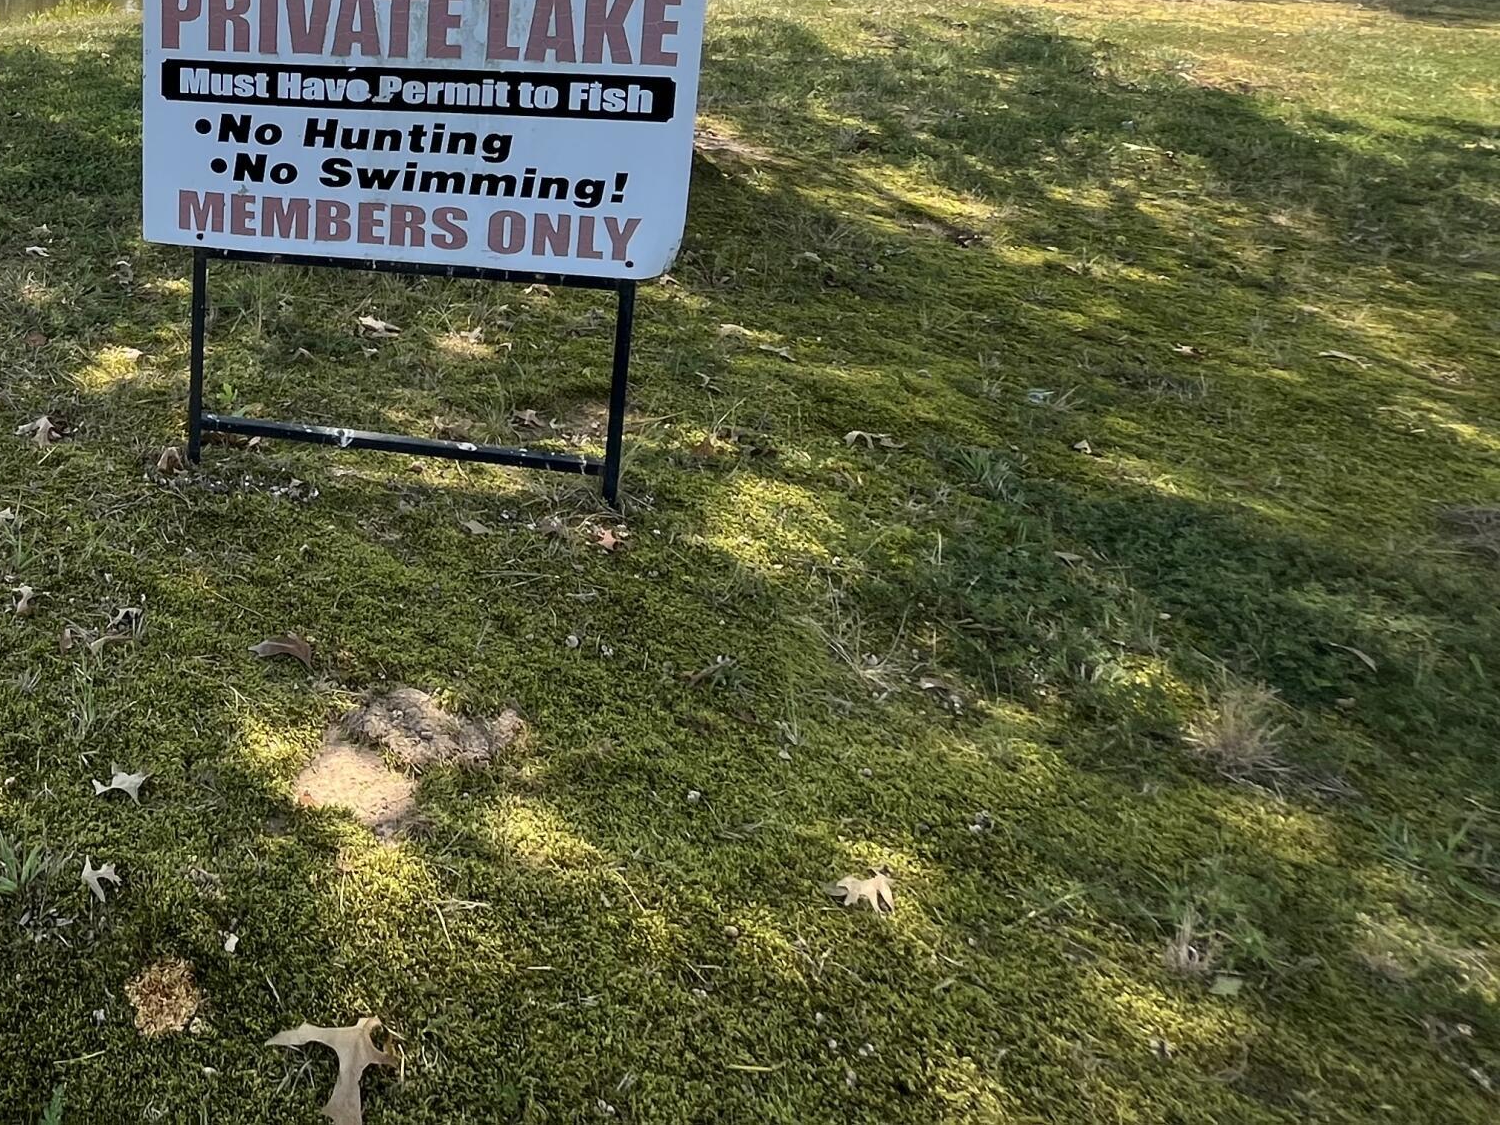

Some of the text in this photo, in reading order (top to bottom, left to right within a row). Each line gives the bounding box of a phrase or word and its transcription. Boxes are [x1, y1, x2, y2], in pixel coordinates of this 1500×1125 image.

[179, 67, 653, 114] Must Have Permit to Fish
[304, 118, 513, 162] Hunting
[319, 158, 629, 208] Swimming!
[178, 190, 643, 262] MEMBERS ONLY
